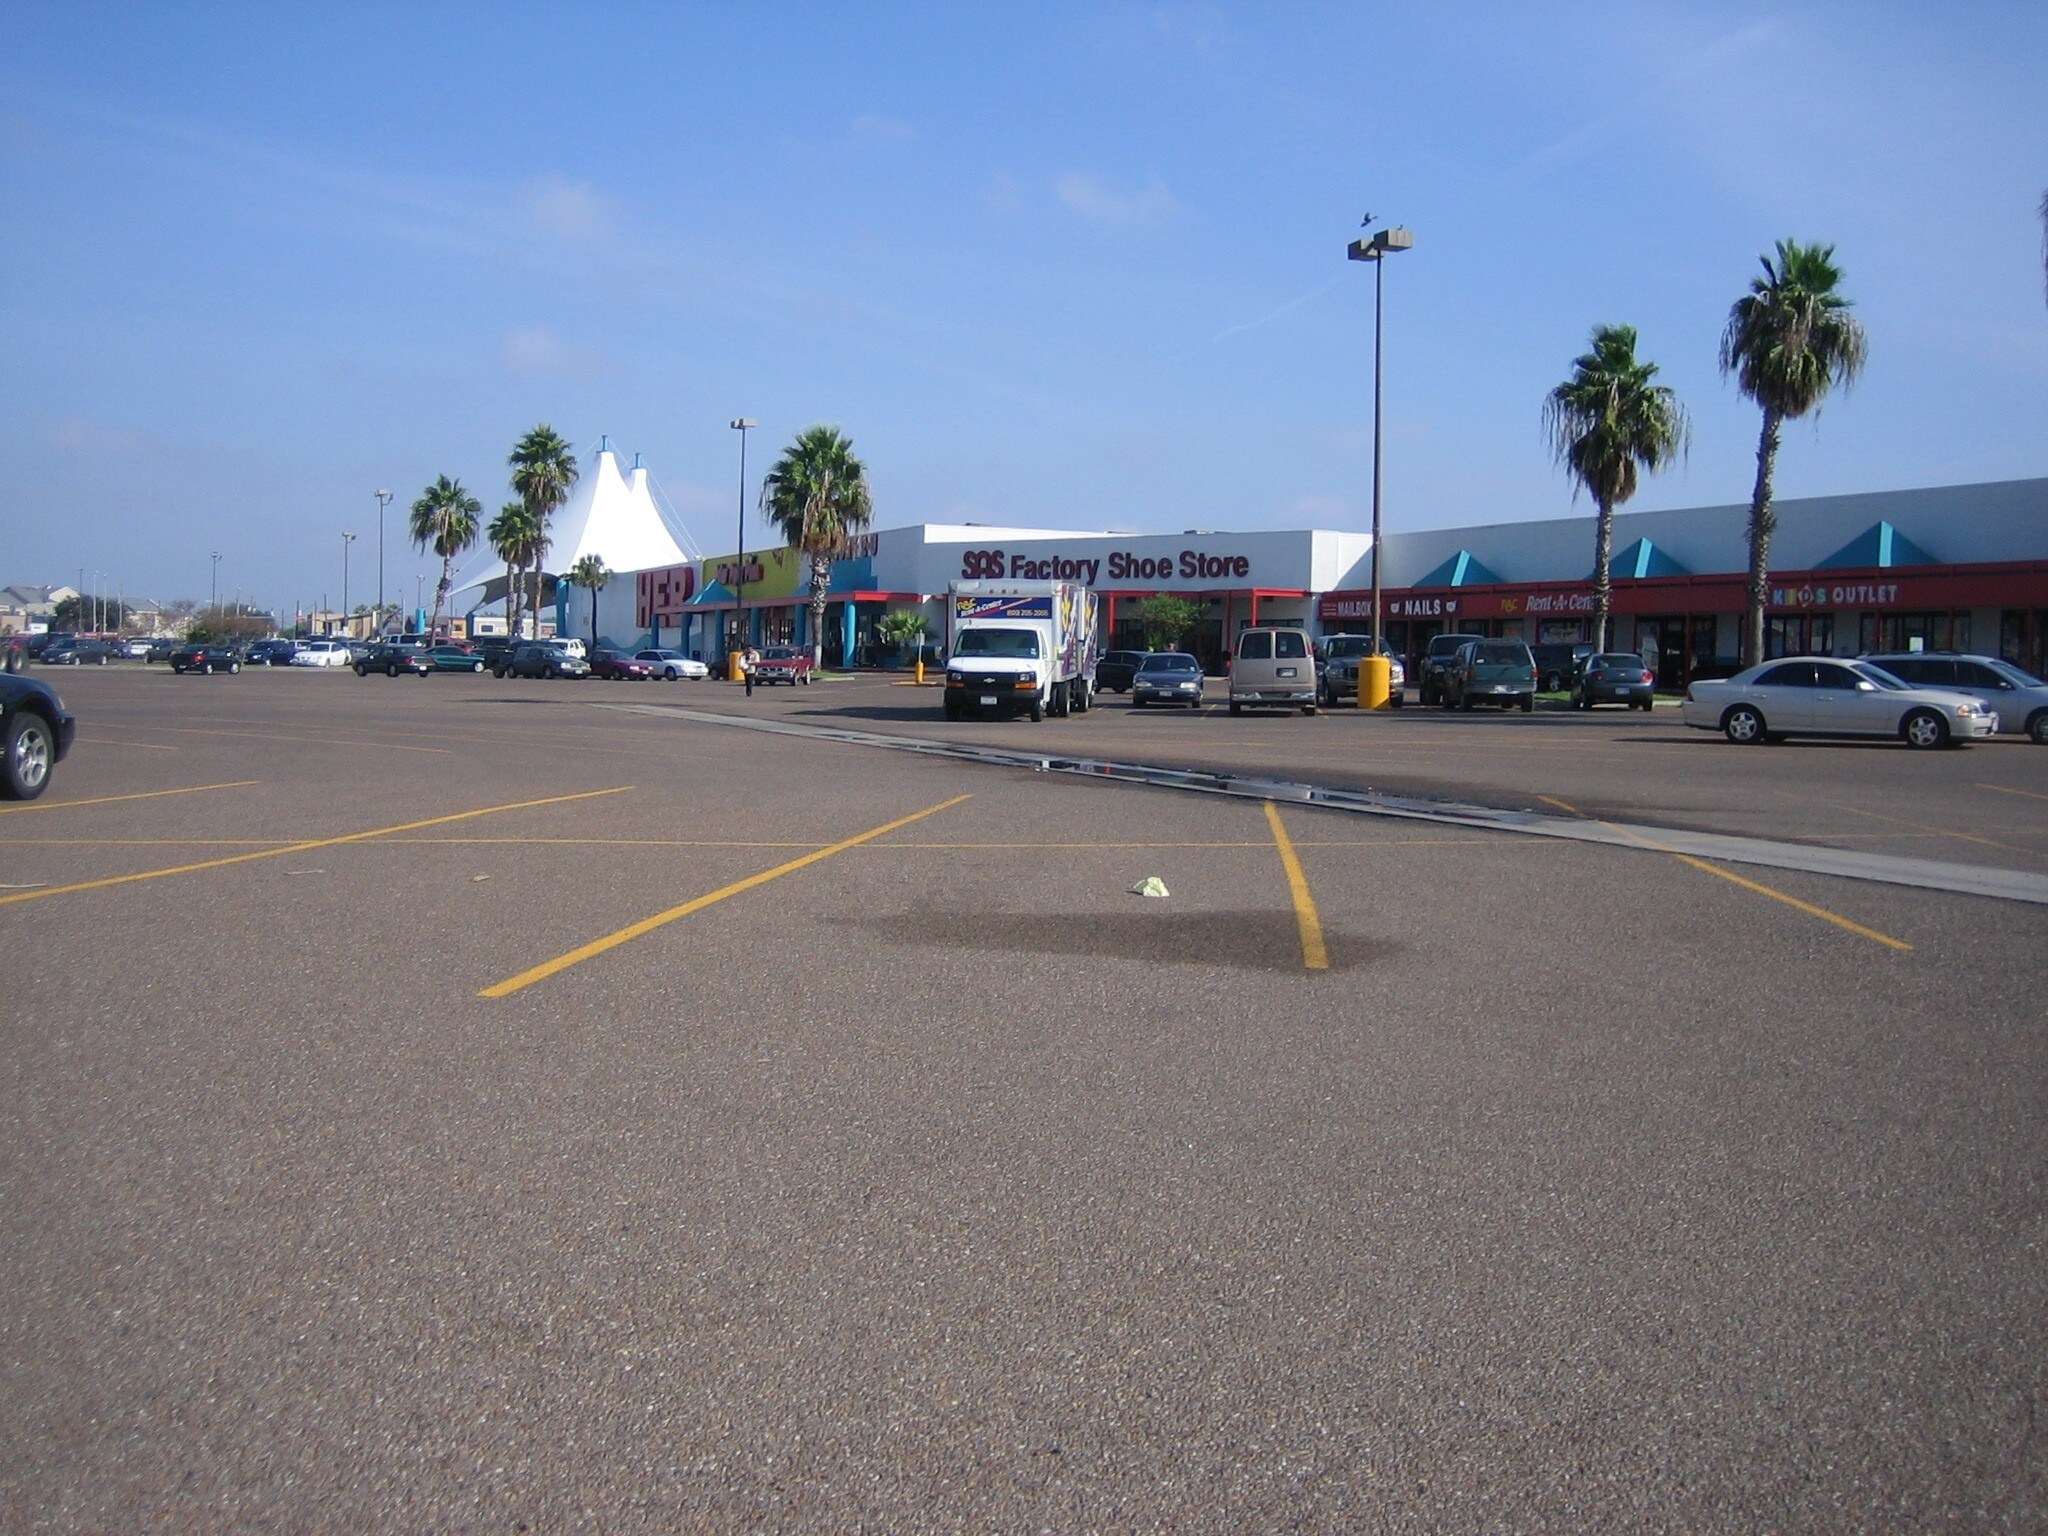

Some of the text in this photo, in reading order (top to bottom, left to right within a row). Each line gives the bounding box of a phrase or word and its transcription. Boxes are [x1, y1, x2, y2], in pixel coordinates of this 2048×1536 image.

[1011, 555, 1100, 585] Factory
[1108, 552, 1173, 579] Shoe
[1179, 550, 1249, 578] Store
[1832, 585, 1898, 604] OUTLET
[1404, 600, 1441, 615] NAILS
